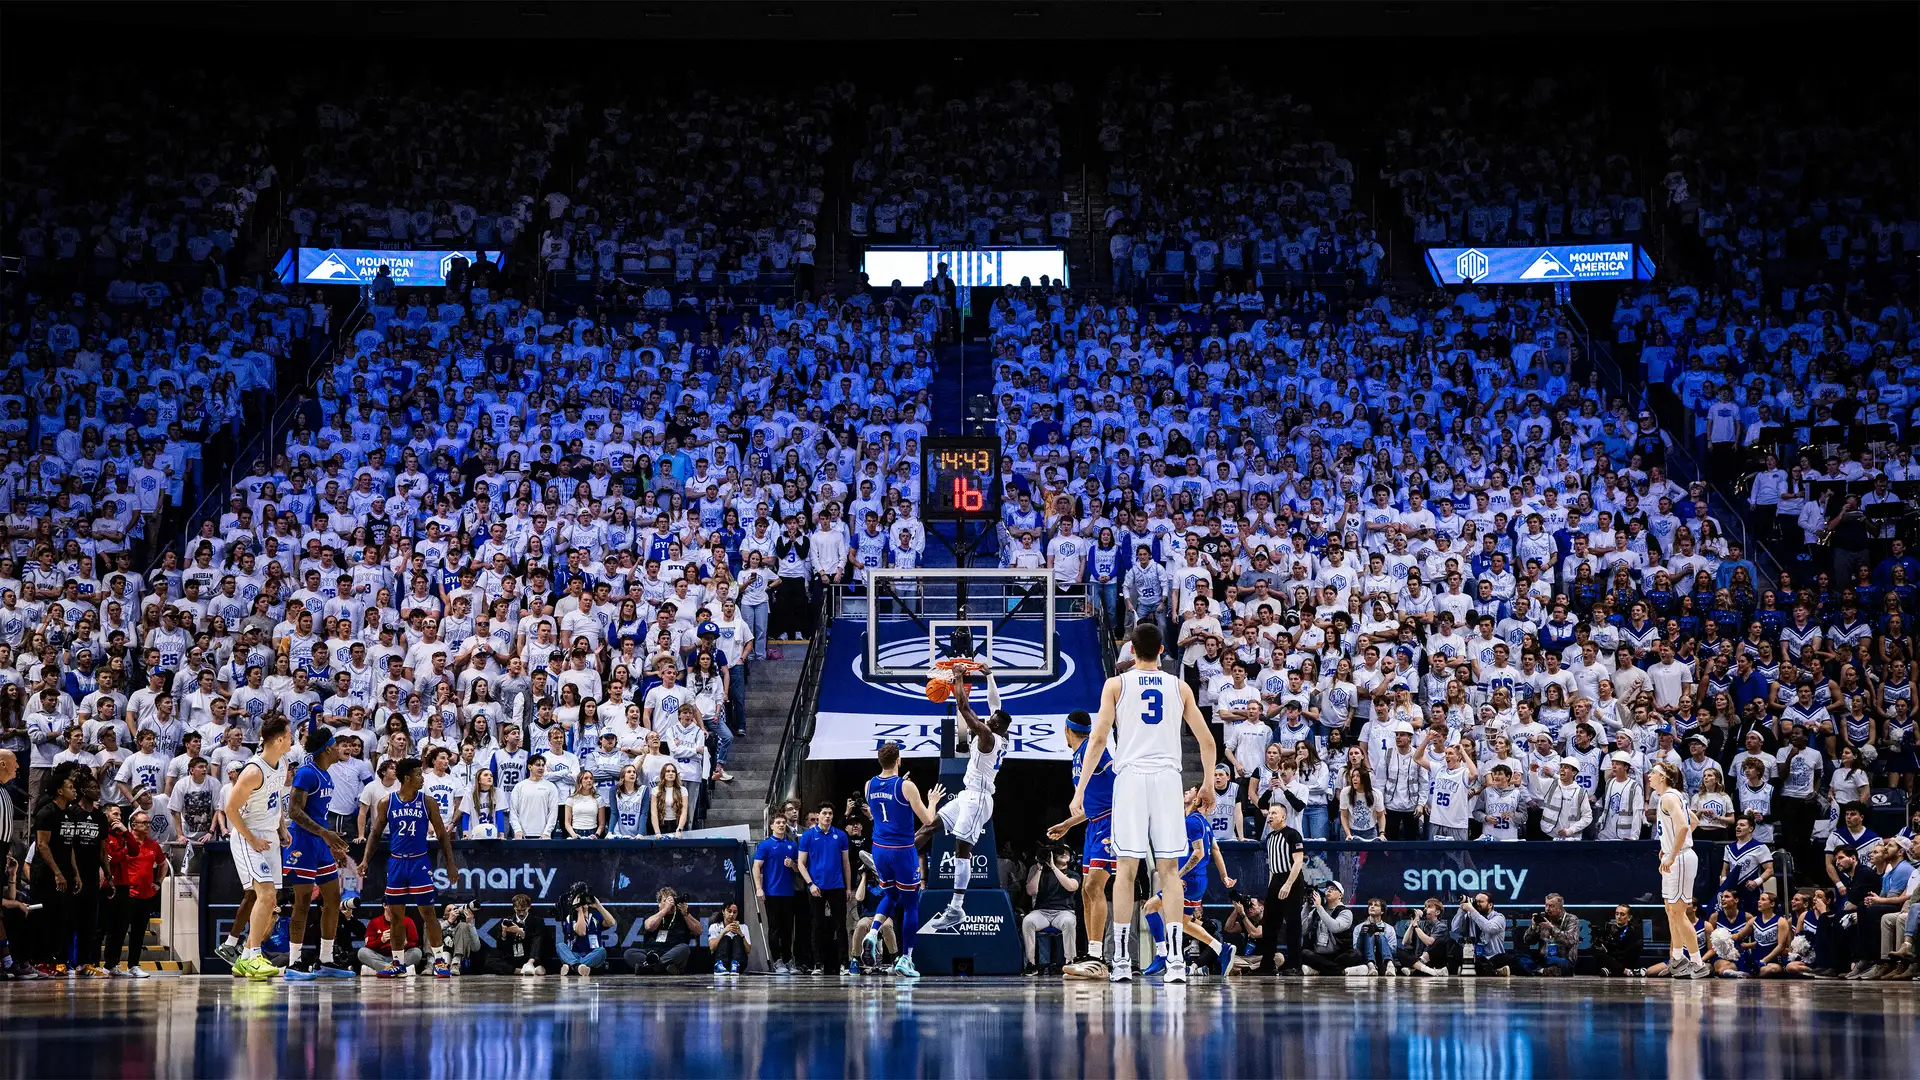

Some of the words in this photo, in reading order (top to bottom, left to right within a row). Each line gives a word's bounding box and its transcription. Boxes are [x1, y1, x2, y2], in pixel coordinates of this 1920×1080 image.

[404, 241, 411, 250] N
[356, 257, 413, 267] MOUNTAIN
[1570, 252, 1628, 262] MOUNTAIN
[1462, 253, 1485, 278] ROC
[1573, 262, 1624, 272] AMERICA
[162, 410, 173, 419] 25
[941, 451, 989, 471] 14:43
[953, 477, 983, 511] 16
[705, 518, 717, 527] 25
[788, 553, 796, 563] 3
[864, 556, 878, 566] 25
[1100, 564, 1110, 573] 25
[162, 654, 178, 665] 25
[1139, 677, 1162, 685] DEMIN
[1141, 689, 1164, 725] 3
[501, 763, 523, 771] BRIGHAM
[1578, 764, 1598, 775] YU
[141, 774, 156, 786] 24
[505, 771, 519, 785] 32
[1577, 776, 1591, 788] 25
[1436, 780, 1459, 792] BYU
[1437, 793, 1450, 806] 25
[392, 809, 423, 818] KANSAS
[479, 812, 493, 824] 24
[880, 803, 888, 822] 1
[621, 813, 635, 826] 25
[1213, 818, 1228, 830] 25
[1494, 818, 1508, 829] 25
[398, 821, 416, 836] 24
[433, 863, 557, 898] smarty
[1404, 864, 1528, 899] smarty
